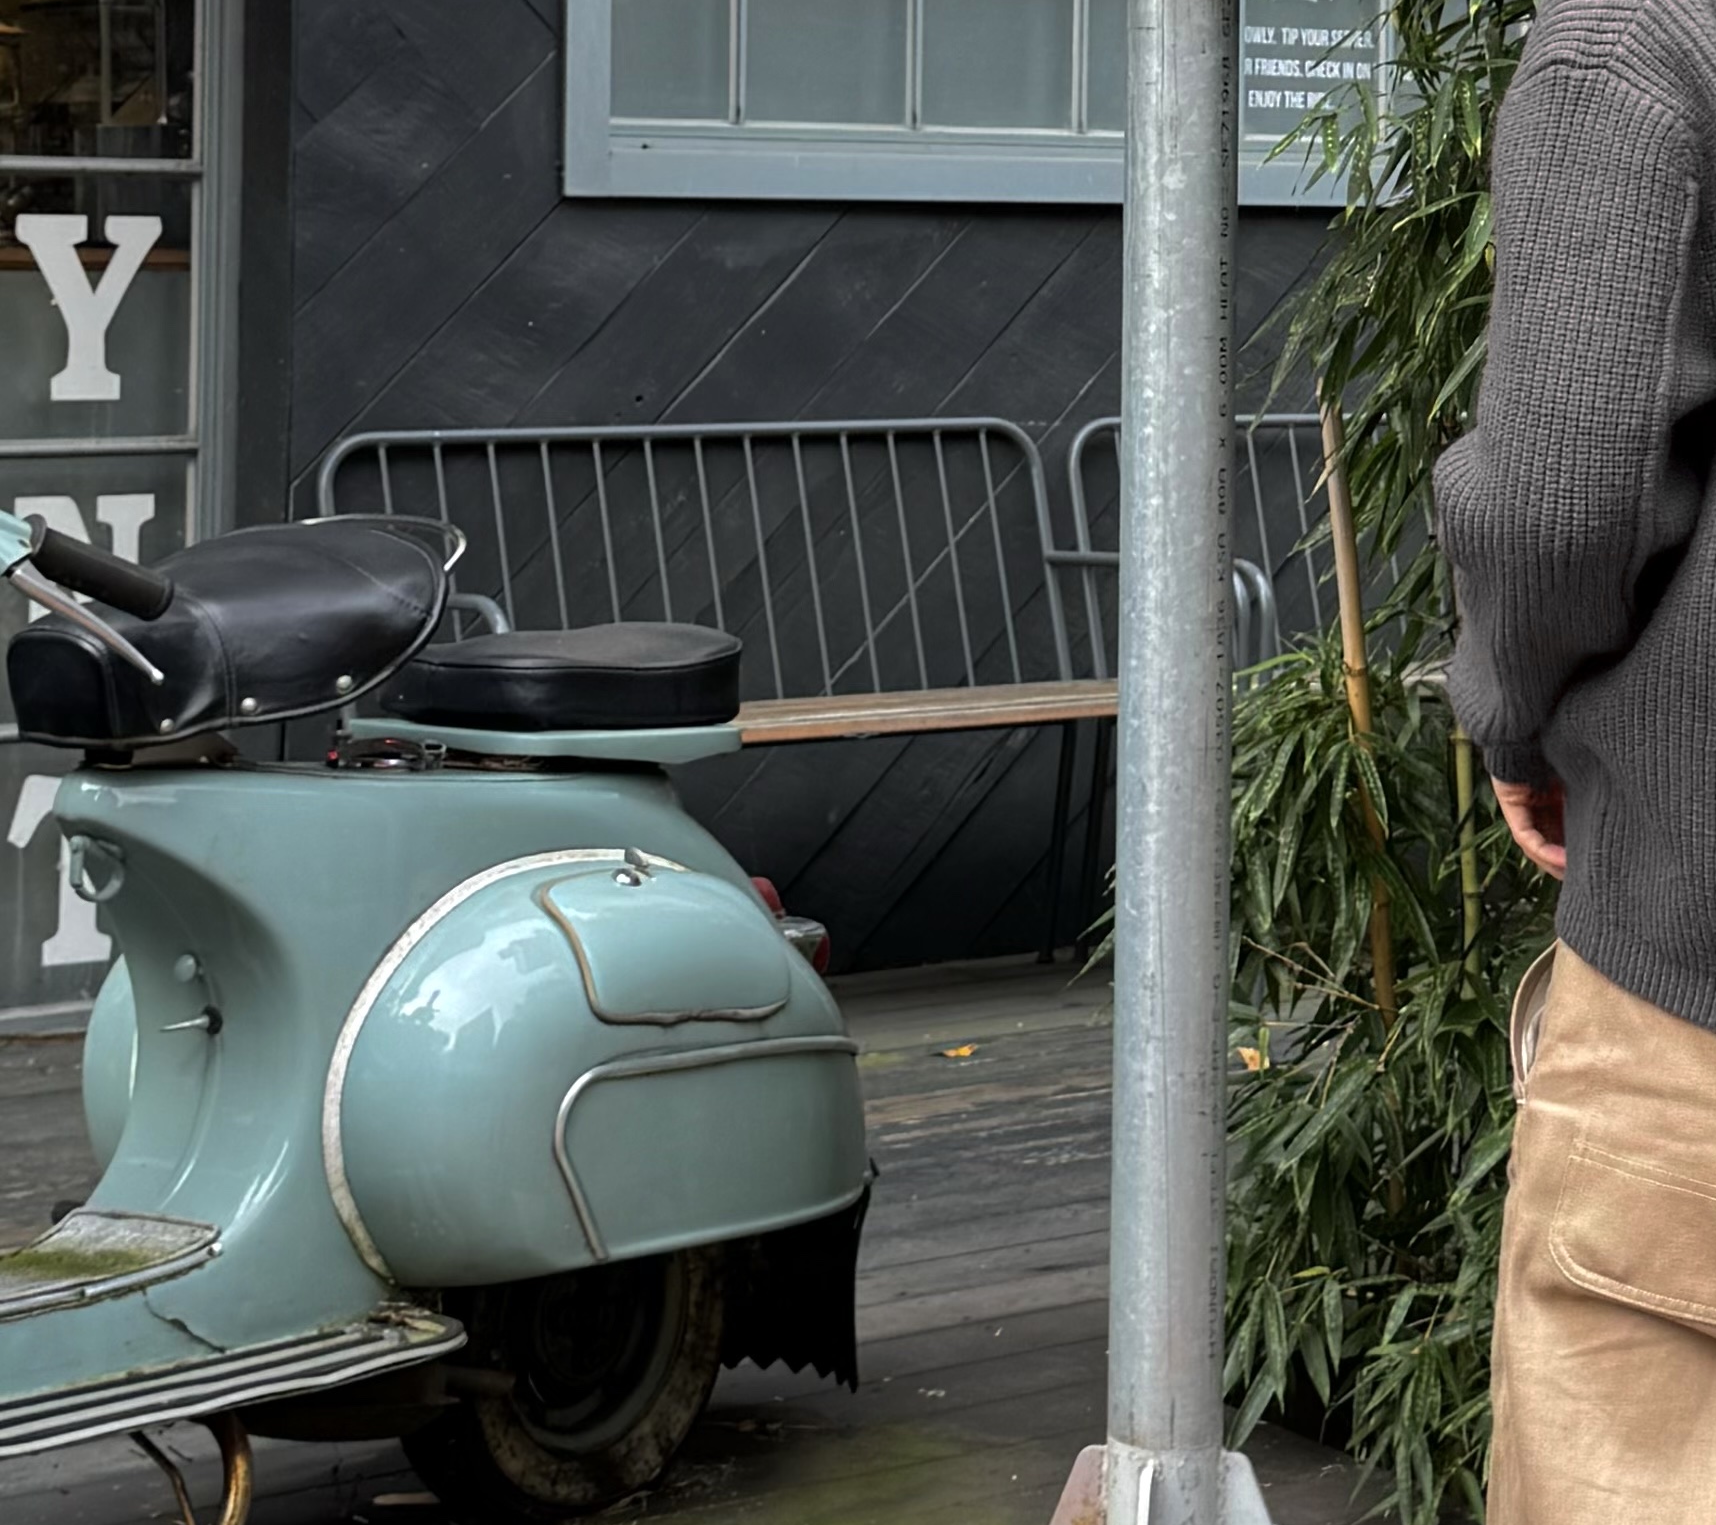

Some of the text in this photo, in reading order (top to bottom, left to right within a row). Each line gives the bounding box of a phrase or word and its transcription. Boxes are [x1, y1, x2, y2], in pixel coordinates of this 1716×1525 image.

[1281, 28, 1299, 46] TIP
[1300, 28, 1330, 47] YOUR
[1248, 89, 1282, 109] ENJOY
[1284, 90, 1306, 109] THE
[15, 214, 163, 401] Y
